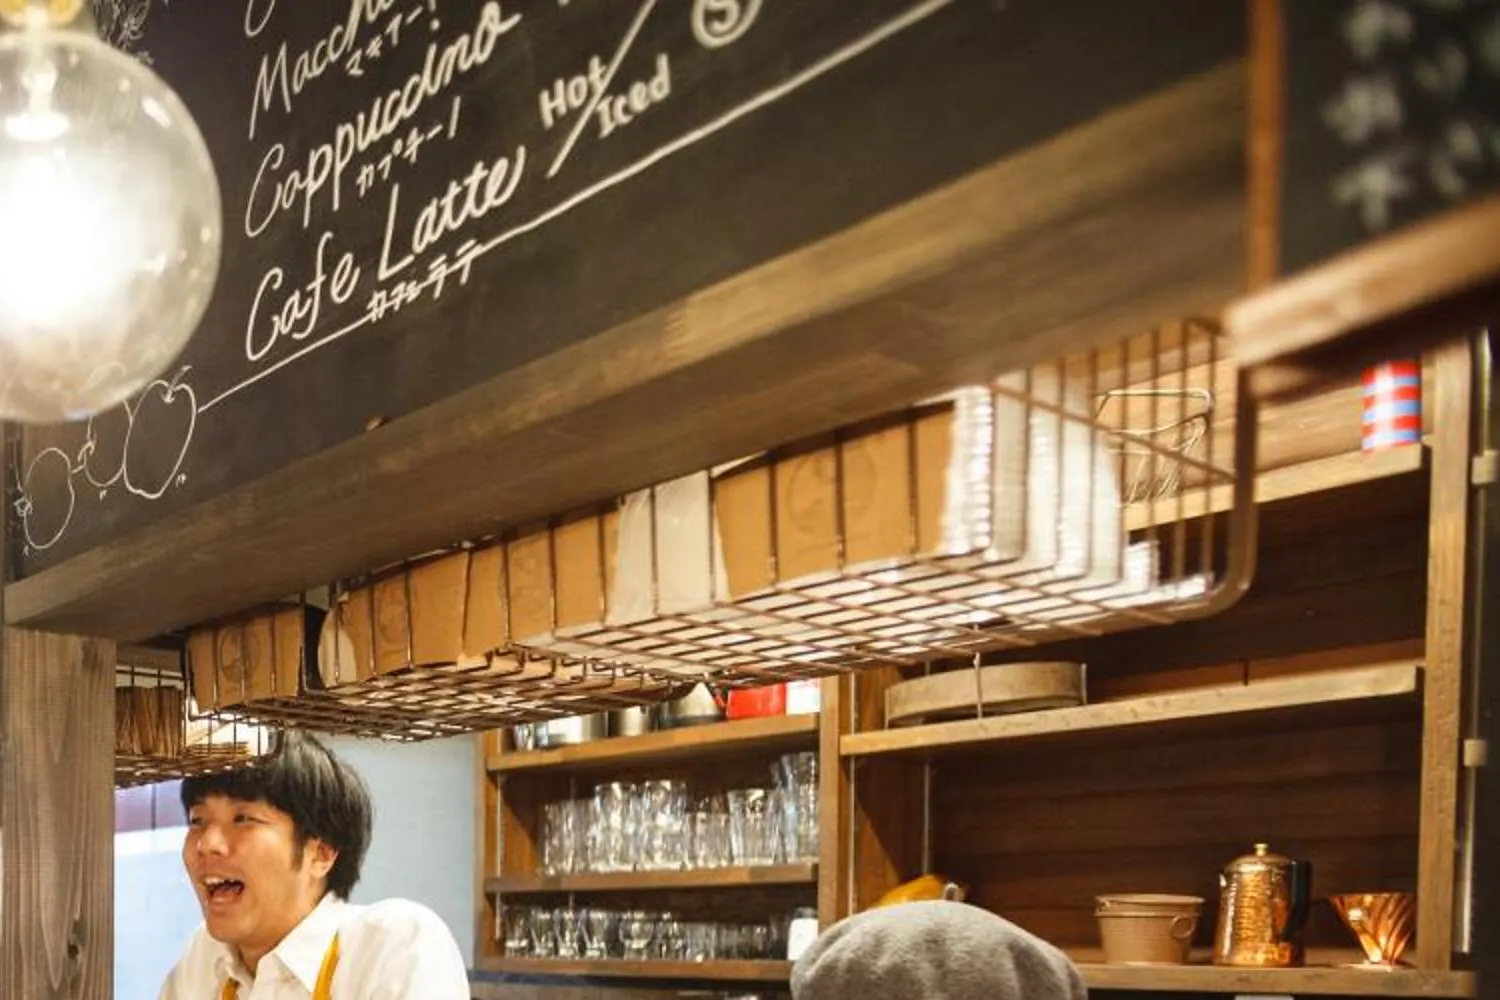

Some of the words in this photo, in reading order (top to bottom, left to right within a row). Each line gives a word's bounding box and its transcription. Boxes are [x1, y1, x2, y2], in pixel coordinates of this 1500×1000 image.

[245, 1, 522, 238] Cappuccino
[248, 0, 396, 140] Macch
[538, 54, 607, 130] Hot
[596, 53, 672, 139] Iced
[245, 231, 361, 361] Cafe
[377, 145, 525, 281] Latte
